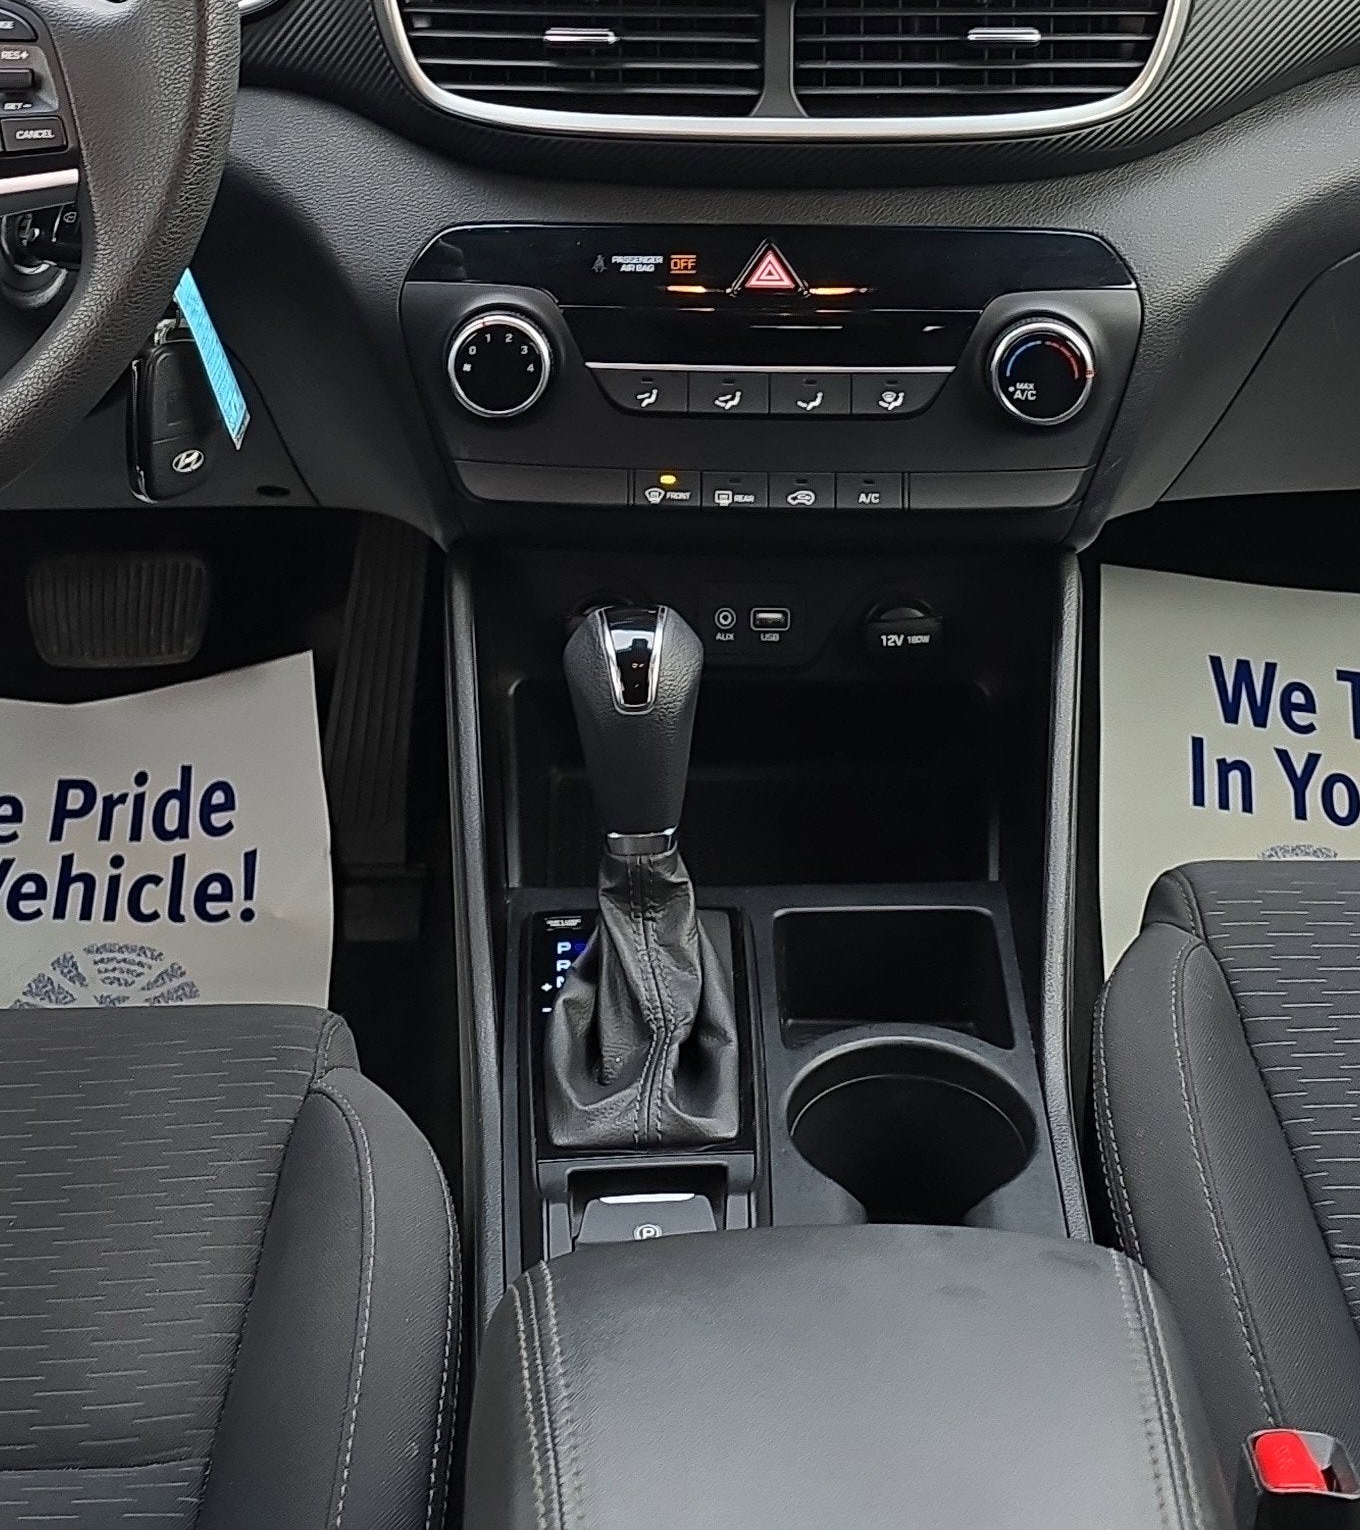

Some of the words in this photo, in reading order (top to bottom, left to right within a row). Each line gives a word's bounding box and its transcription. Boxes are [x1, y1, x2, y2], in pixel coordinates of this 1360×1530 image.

[15, 129, 55, 140] CANCEL
[611, 255, 664, 264] PASSENGER
[670, 258, 696, 270] OFF
[620, 264, 635, 272] AIR
[636, 264, 655, 272] BAG
[485, 333, 491, 344] 1
[505, 333, 513, 343] 2
[468, 345, 477, 355] 0
[520, 345, 528, 355] 3
[526, 363, 534, 373] 4
[1016, 382, 1035, 390] MAX
[1013, 389, 1037, 401] A/C
[665, 491, 691, 501] FRONT
[734, 494, 755, 504] REAR
[858, 493, 880, 504] A/C
[715, 632, 735, 641] AUX
[760, 632, 780, 642] USB
[880, 634, 904, 647] 12V
[1207, 654, 1318, 736] We
[1190, 735, 1254, 815] In
[48, 763, 237, 844] Pride
[556, 941, 572, 955] P
